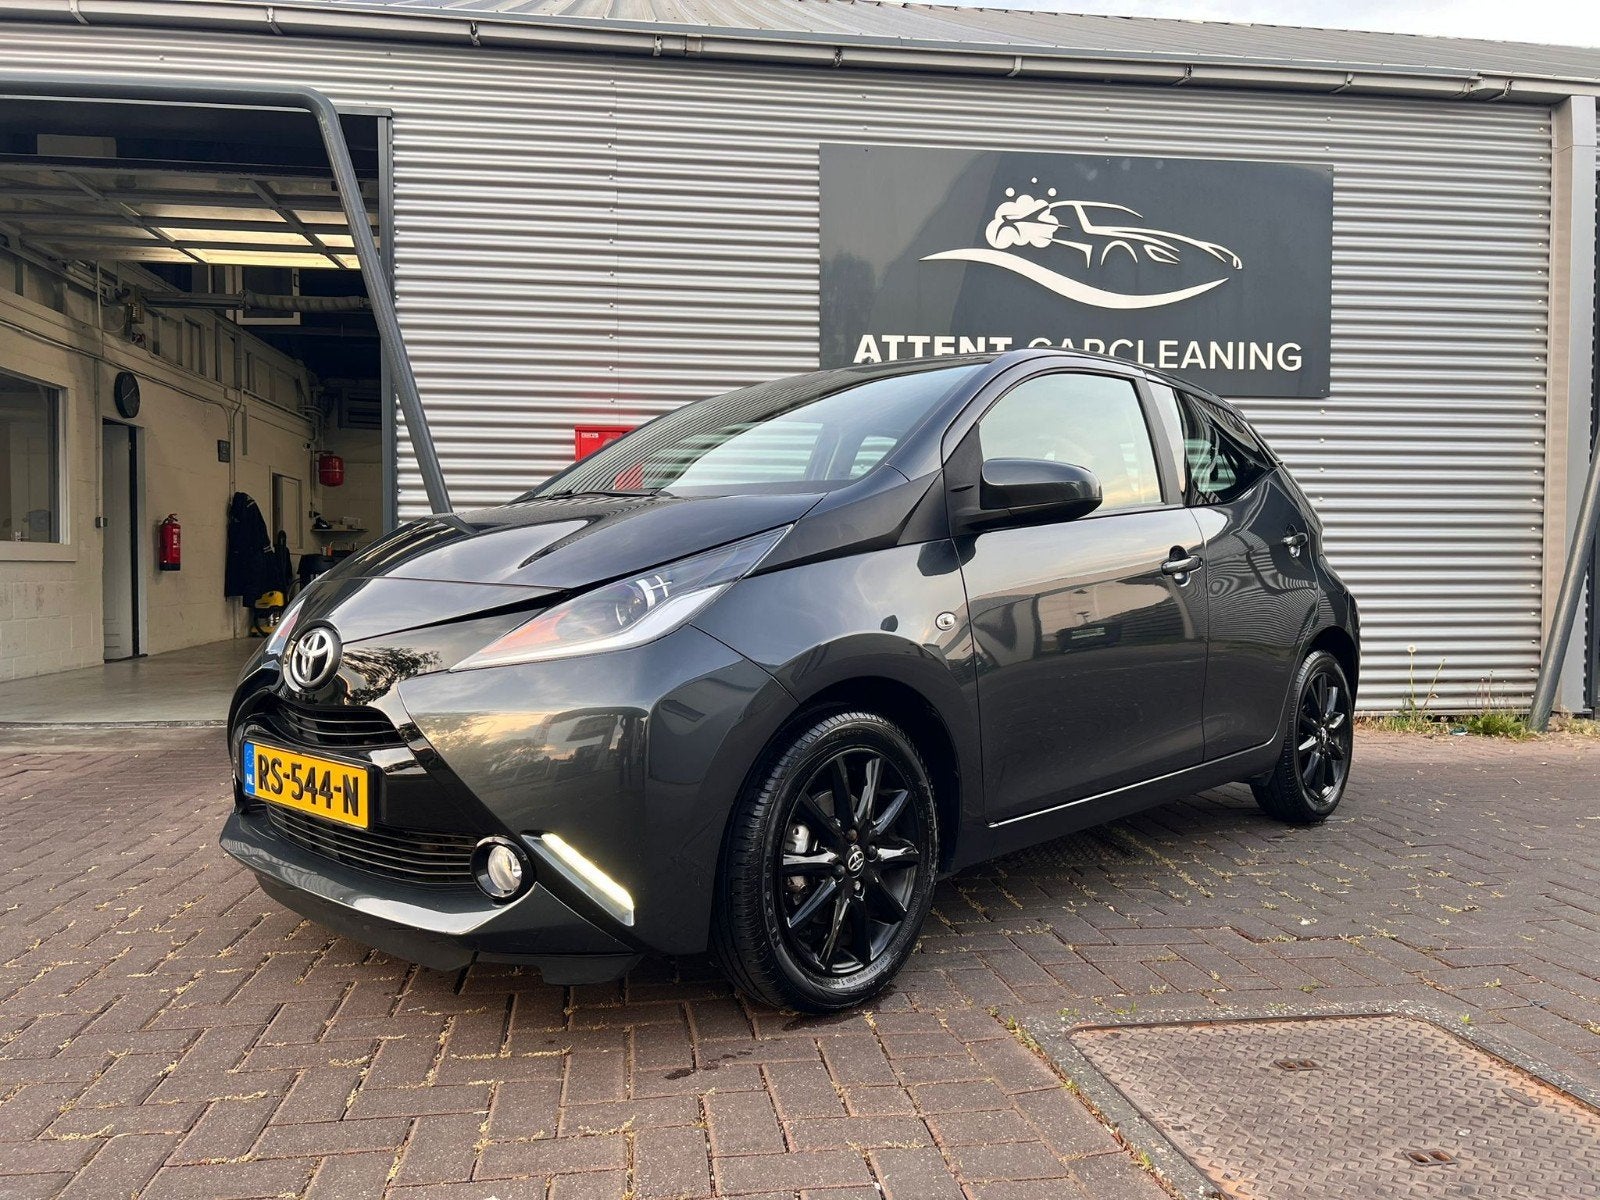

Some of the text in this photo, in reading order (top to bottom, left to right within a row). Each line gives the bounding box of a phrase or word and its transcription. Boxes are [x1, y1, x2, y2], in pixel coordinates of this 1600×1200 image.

[853, 334, 1013, 363] ATTENT
[246, 773, 254, 786] NL
[258, 754, 359, 817] RS-544-N
